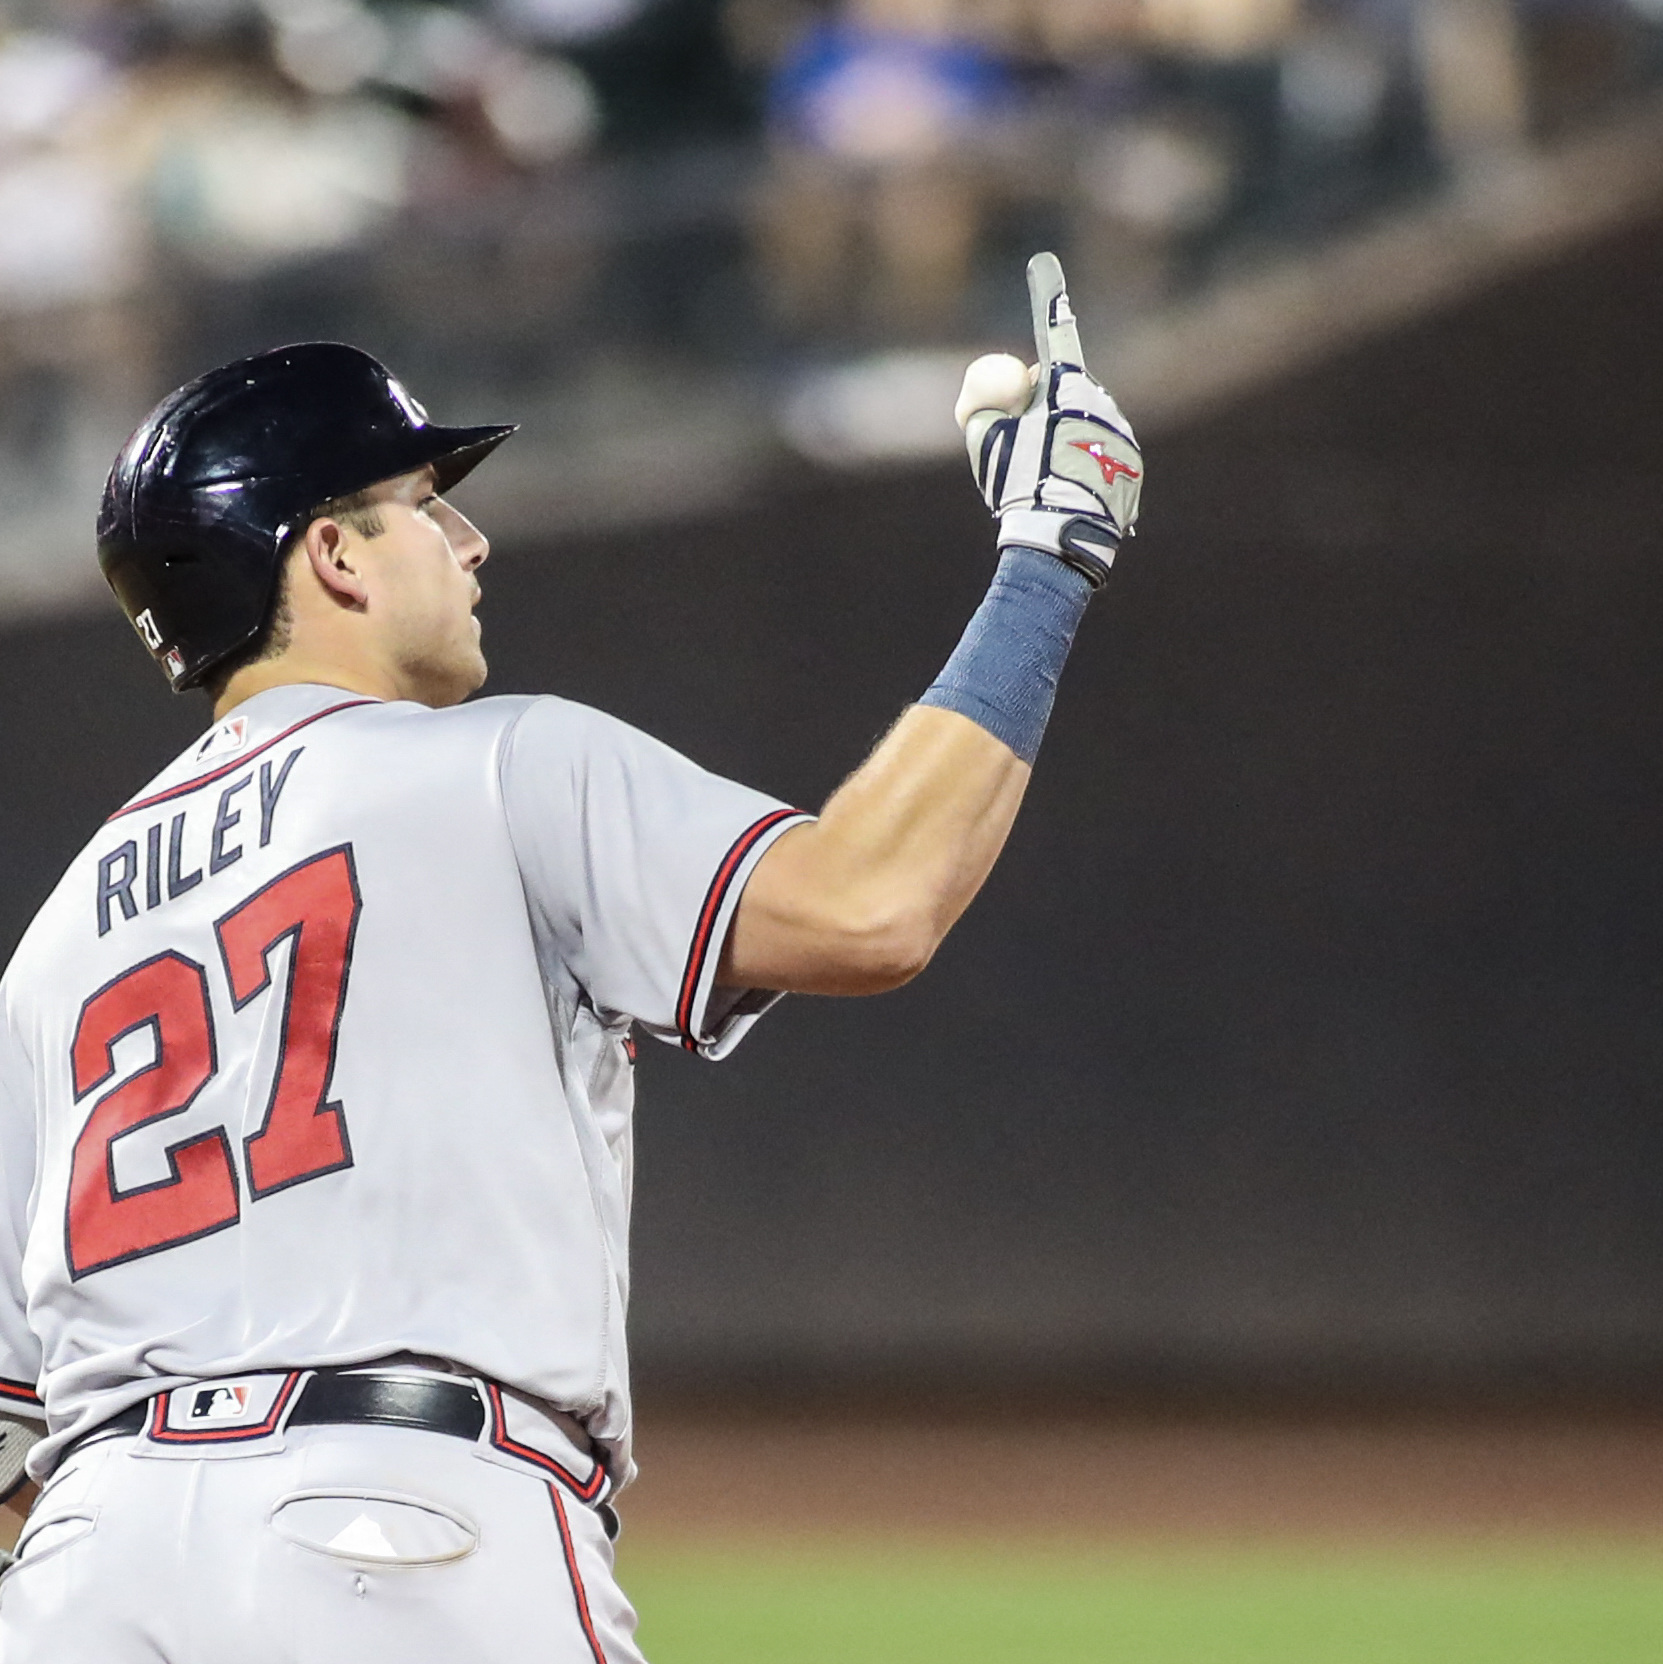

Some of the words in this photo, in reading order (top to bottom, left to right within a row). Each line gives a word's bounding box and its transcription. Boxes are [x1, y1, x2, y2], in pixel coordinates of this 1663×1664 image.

[136, 608, 163, 650] 27
[97, 746, 305, 938] RILEY
[64, 842, 363, 1283] 27
